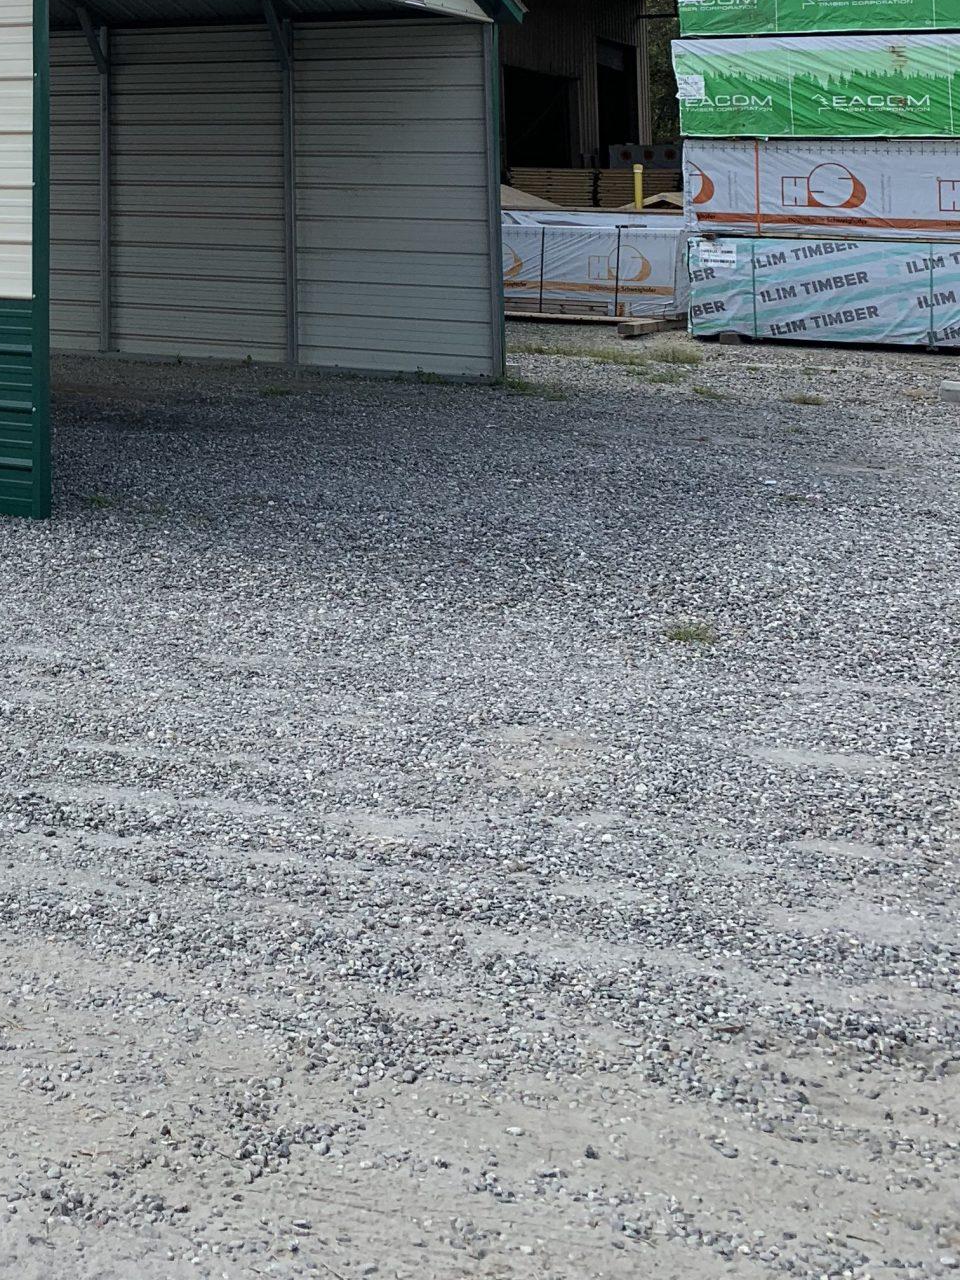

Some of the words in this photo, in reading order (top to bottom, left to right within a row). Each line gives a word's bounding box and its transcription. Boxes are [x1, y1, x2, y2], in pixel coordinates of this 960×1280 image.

[685, 95, 772, 107] EACOM
[832, 94, 930, 107] EACOM
[751, 251, 787, 269] ILIM
[906, 256, 946, 274] ILIM
[760, 285, 797, 303] ILIM
[800, 271, 869, 295] TIMBER
[916, 290, 957, 309] ILIM
[770, 318, 807, 336] ILIM
[810, 305, 880, 329] TIMBER
